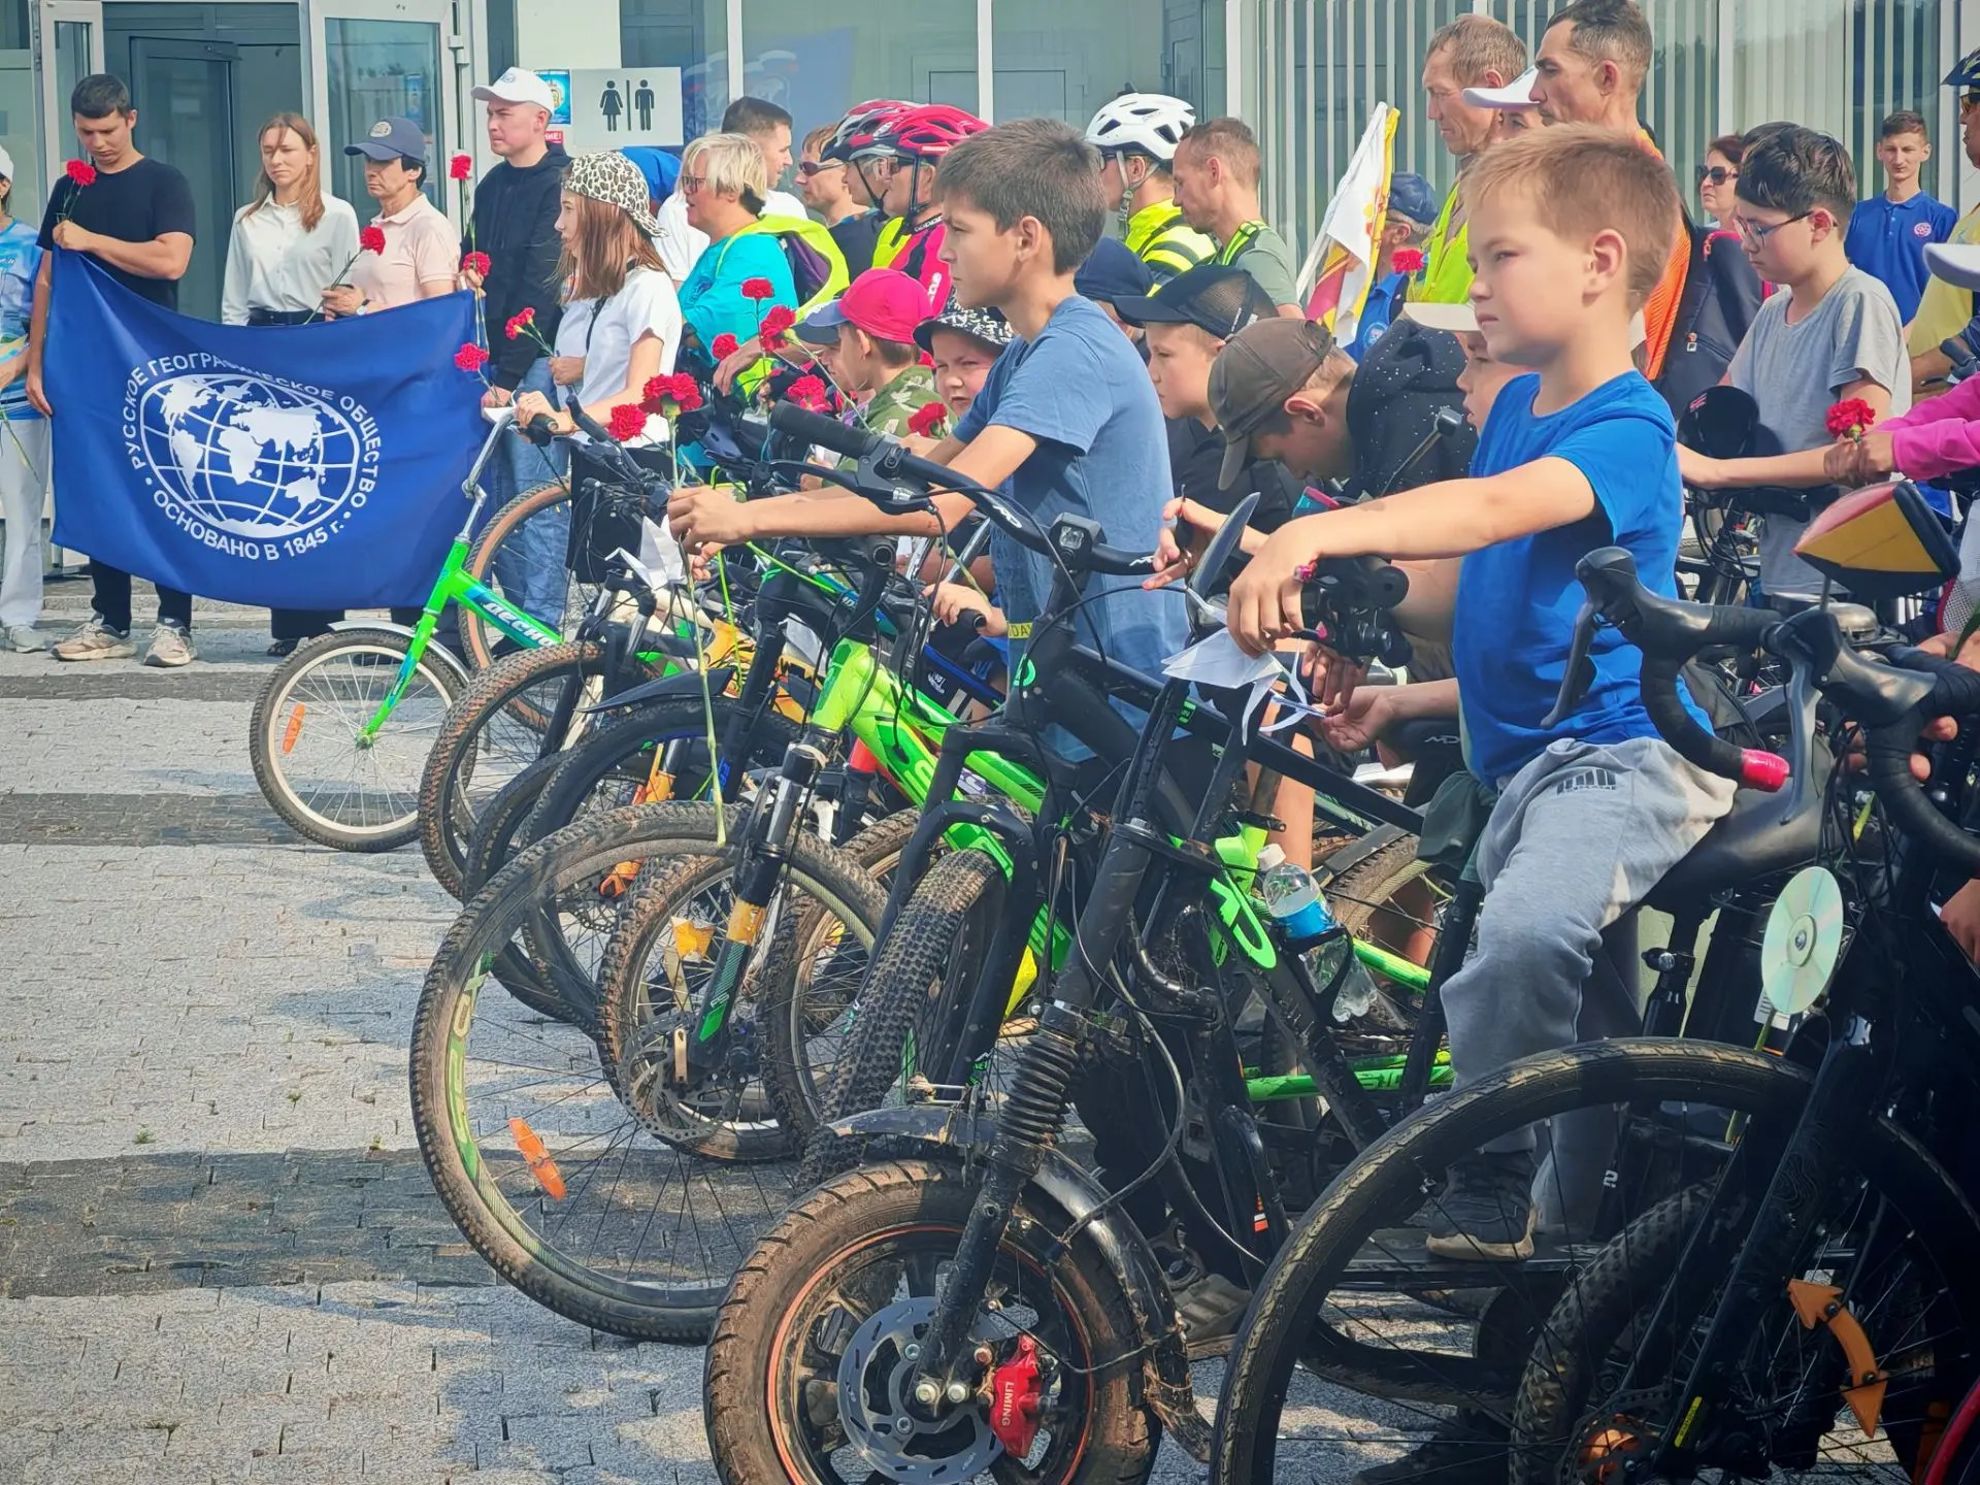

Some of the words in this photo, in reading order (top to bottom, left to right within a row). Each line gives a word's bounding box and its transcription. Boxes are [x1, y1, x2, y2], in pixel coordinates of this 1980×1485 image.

[122, 367, 149, 469] РУССКОЕ
[147, 352, 335, 400] ГЕОГРАЕСКОЕ
[340, 396, 381, 508] ОБЩЕСТВО
[153, 490, 259, 560] ОСНОВАНО
[264, 544, 280, 561] В
[284, 526, 328, 557] 1845
[330, 520, 344, 534] г.
[1002, 1381, 1015, 1426] LIMING
